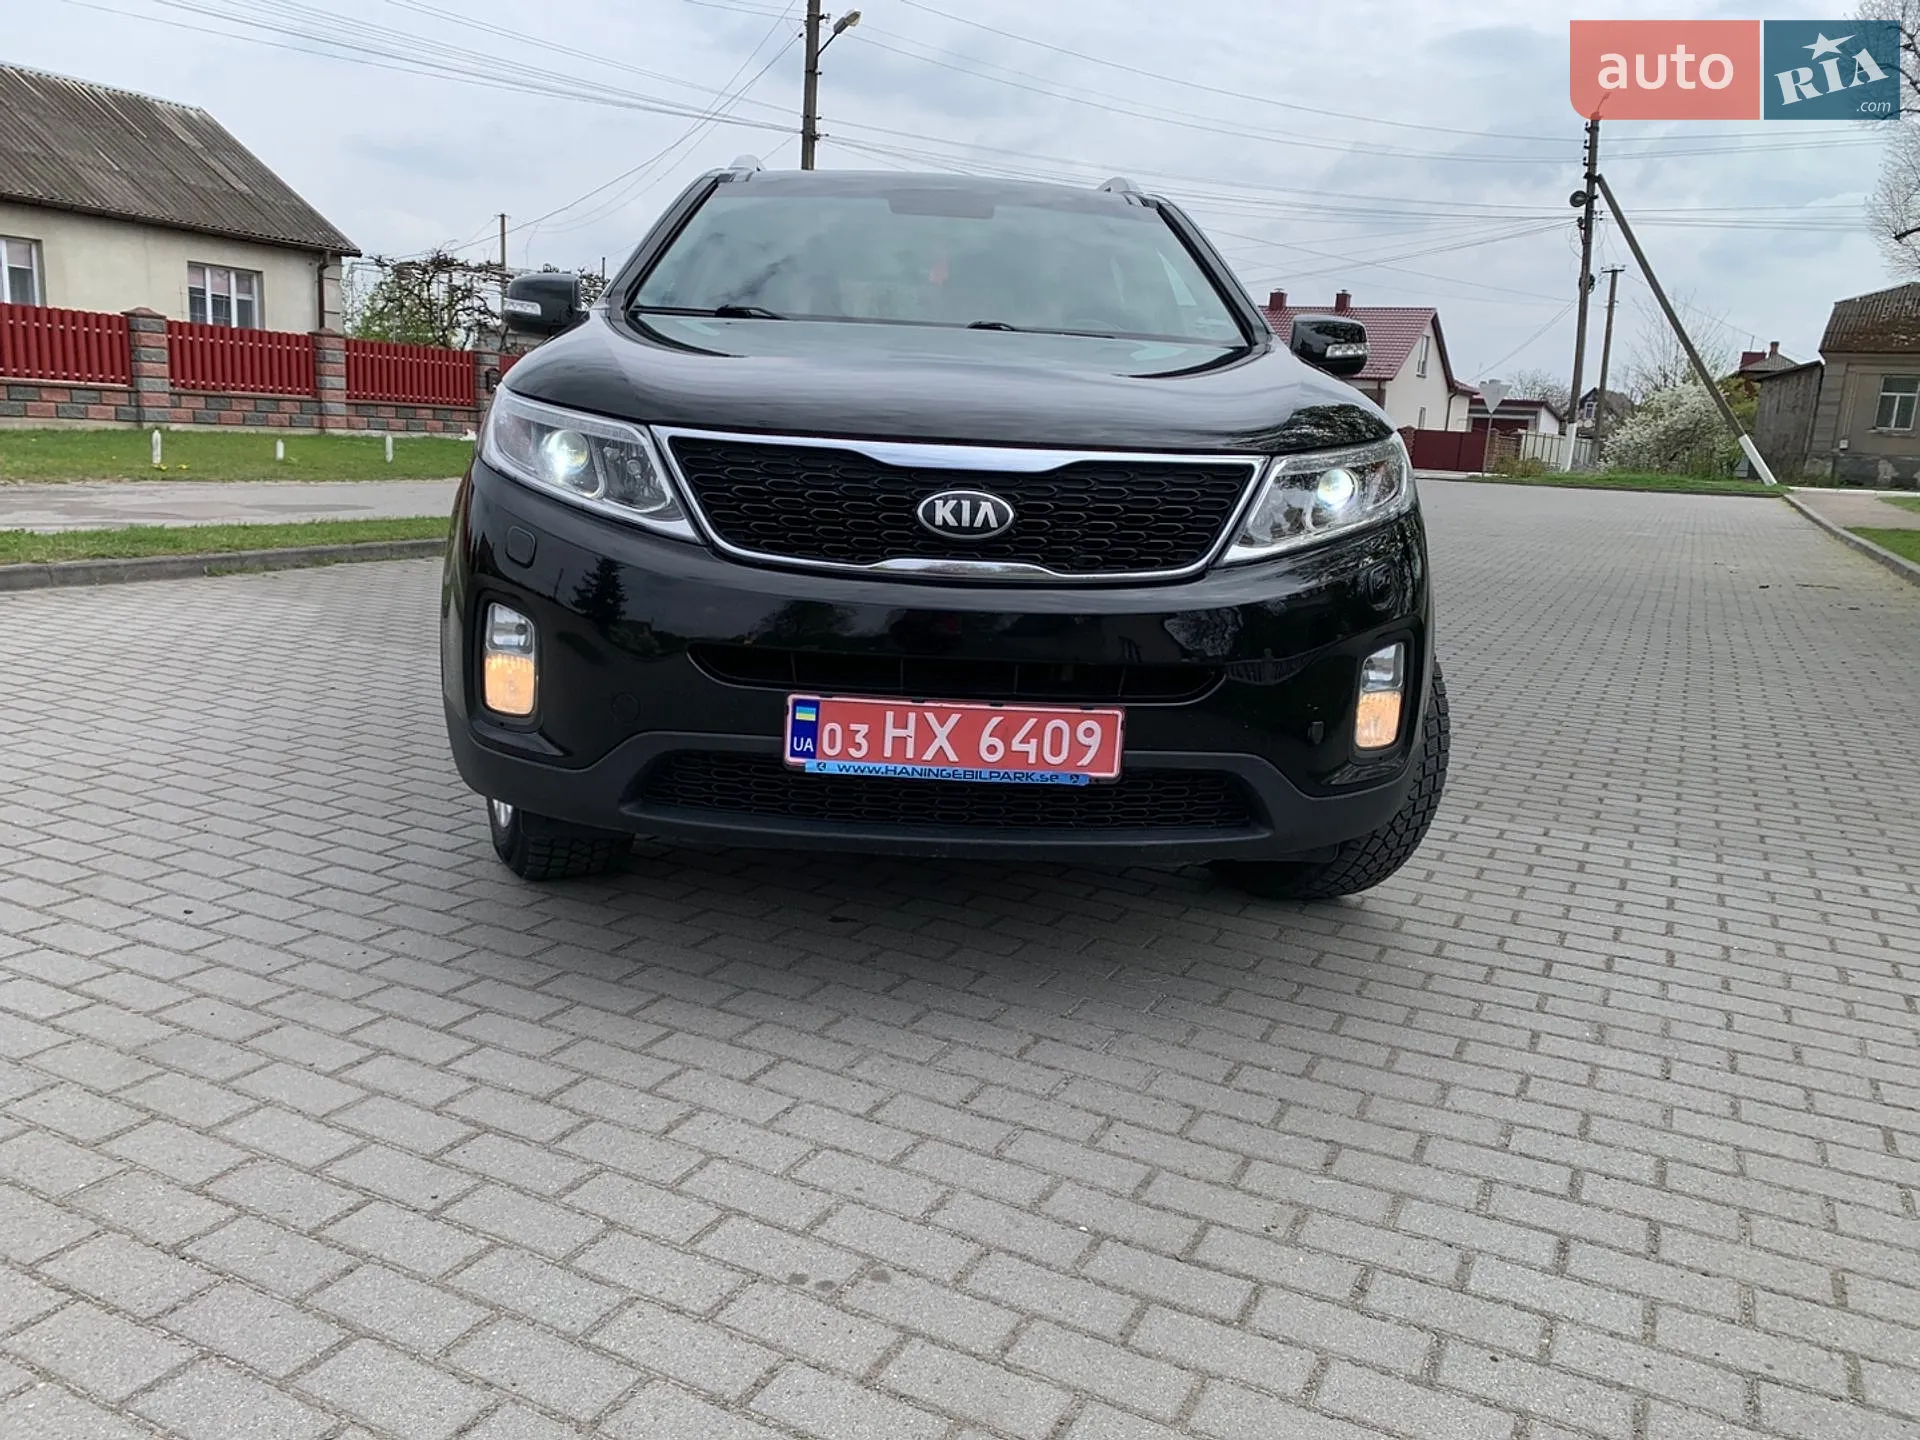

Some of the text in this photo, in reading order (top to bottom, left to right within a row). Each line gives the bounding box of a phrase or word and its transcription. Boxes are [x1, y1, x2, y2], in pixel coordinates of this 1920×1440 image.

[934, 499, 999, 528] KIA
[793, 736, 815, 752] UA
[821, 710, 1102, 767] 03 HX 6409
